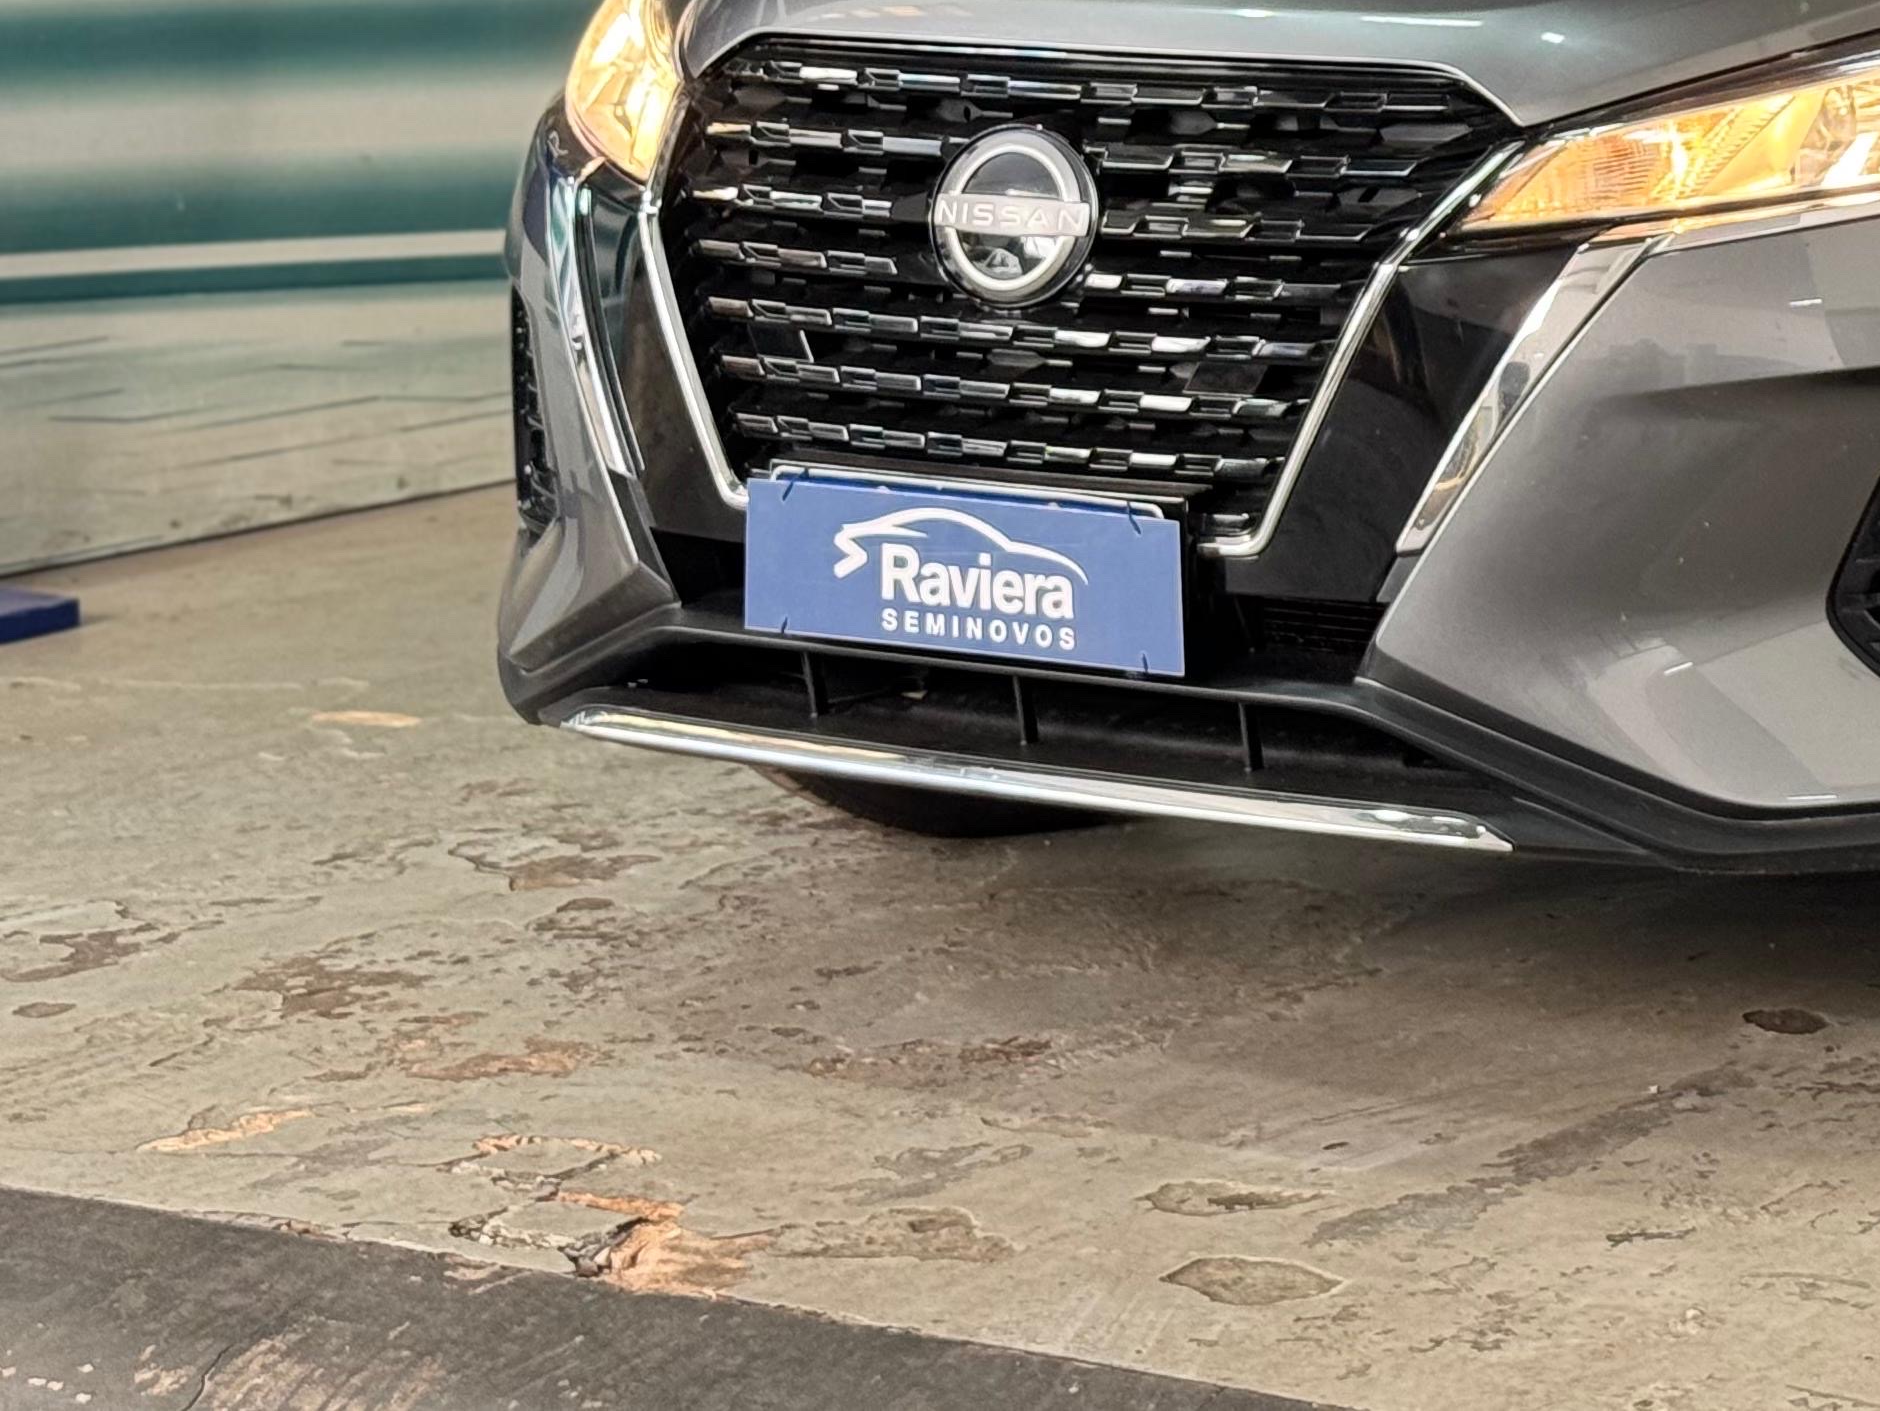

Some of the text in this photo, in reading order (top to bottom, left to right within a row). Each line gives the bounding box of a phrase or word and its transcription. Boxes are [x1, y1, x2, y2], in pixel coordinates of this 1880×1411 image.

[936, 199, 1085, 233] NISSAN
[881, 542, 1076, 620] Raviera
[881, 607, 1077, 651] SEMINOVOS
